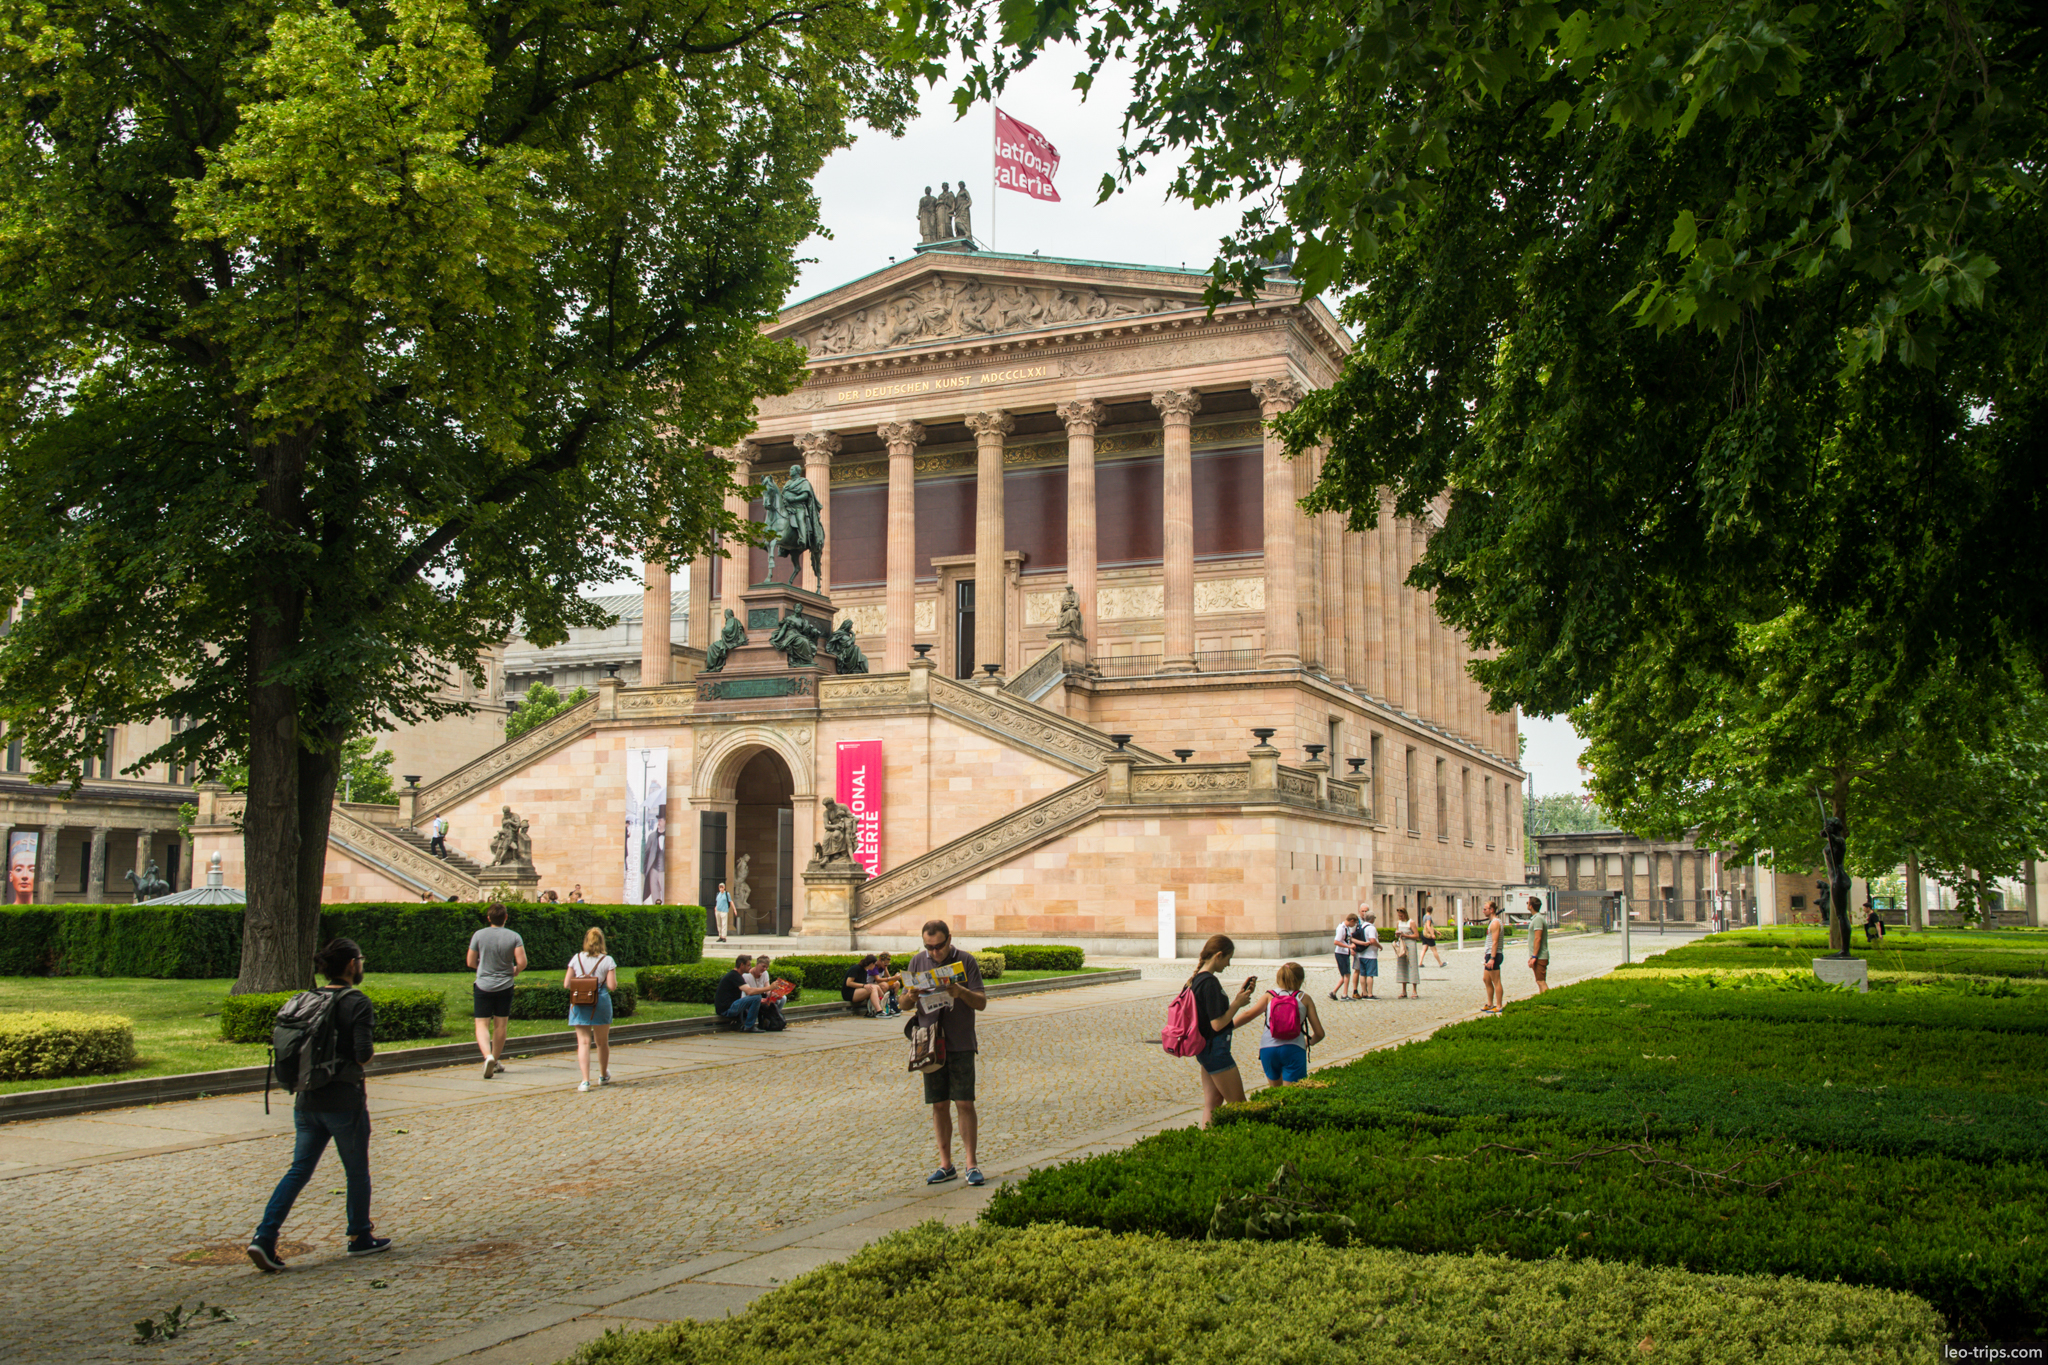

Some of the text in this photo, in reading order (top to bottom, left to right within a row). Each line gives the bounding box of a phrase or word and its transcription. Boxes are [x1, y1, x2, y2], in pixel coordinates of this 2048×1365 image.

[838, 366, 1046, 401] DER DEUTSCHEN KUNST MDCCCLXXI
[632, 838, 640, 899] CAILLEBOTTE
[865, 811, 878, 882] ALERIE
